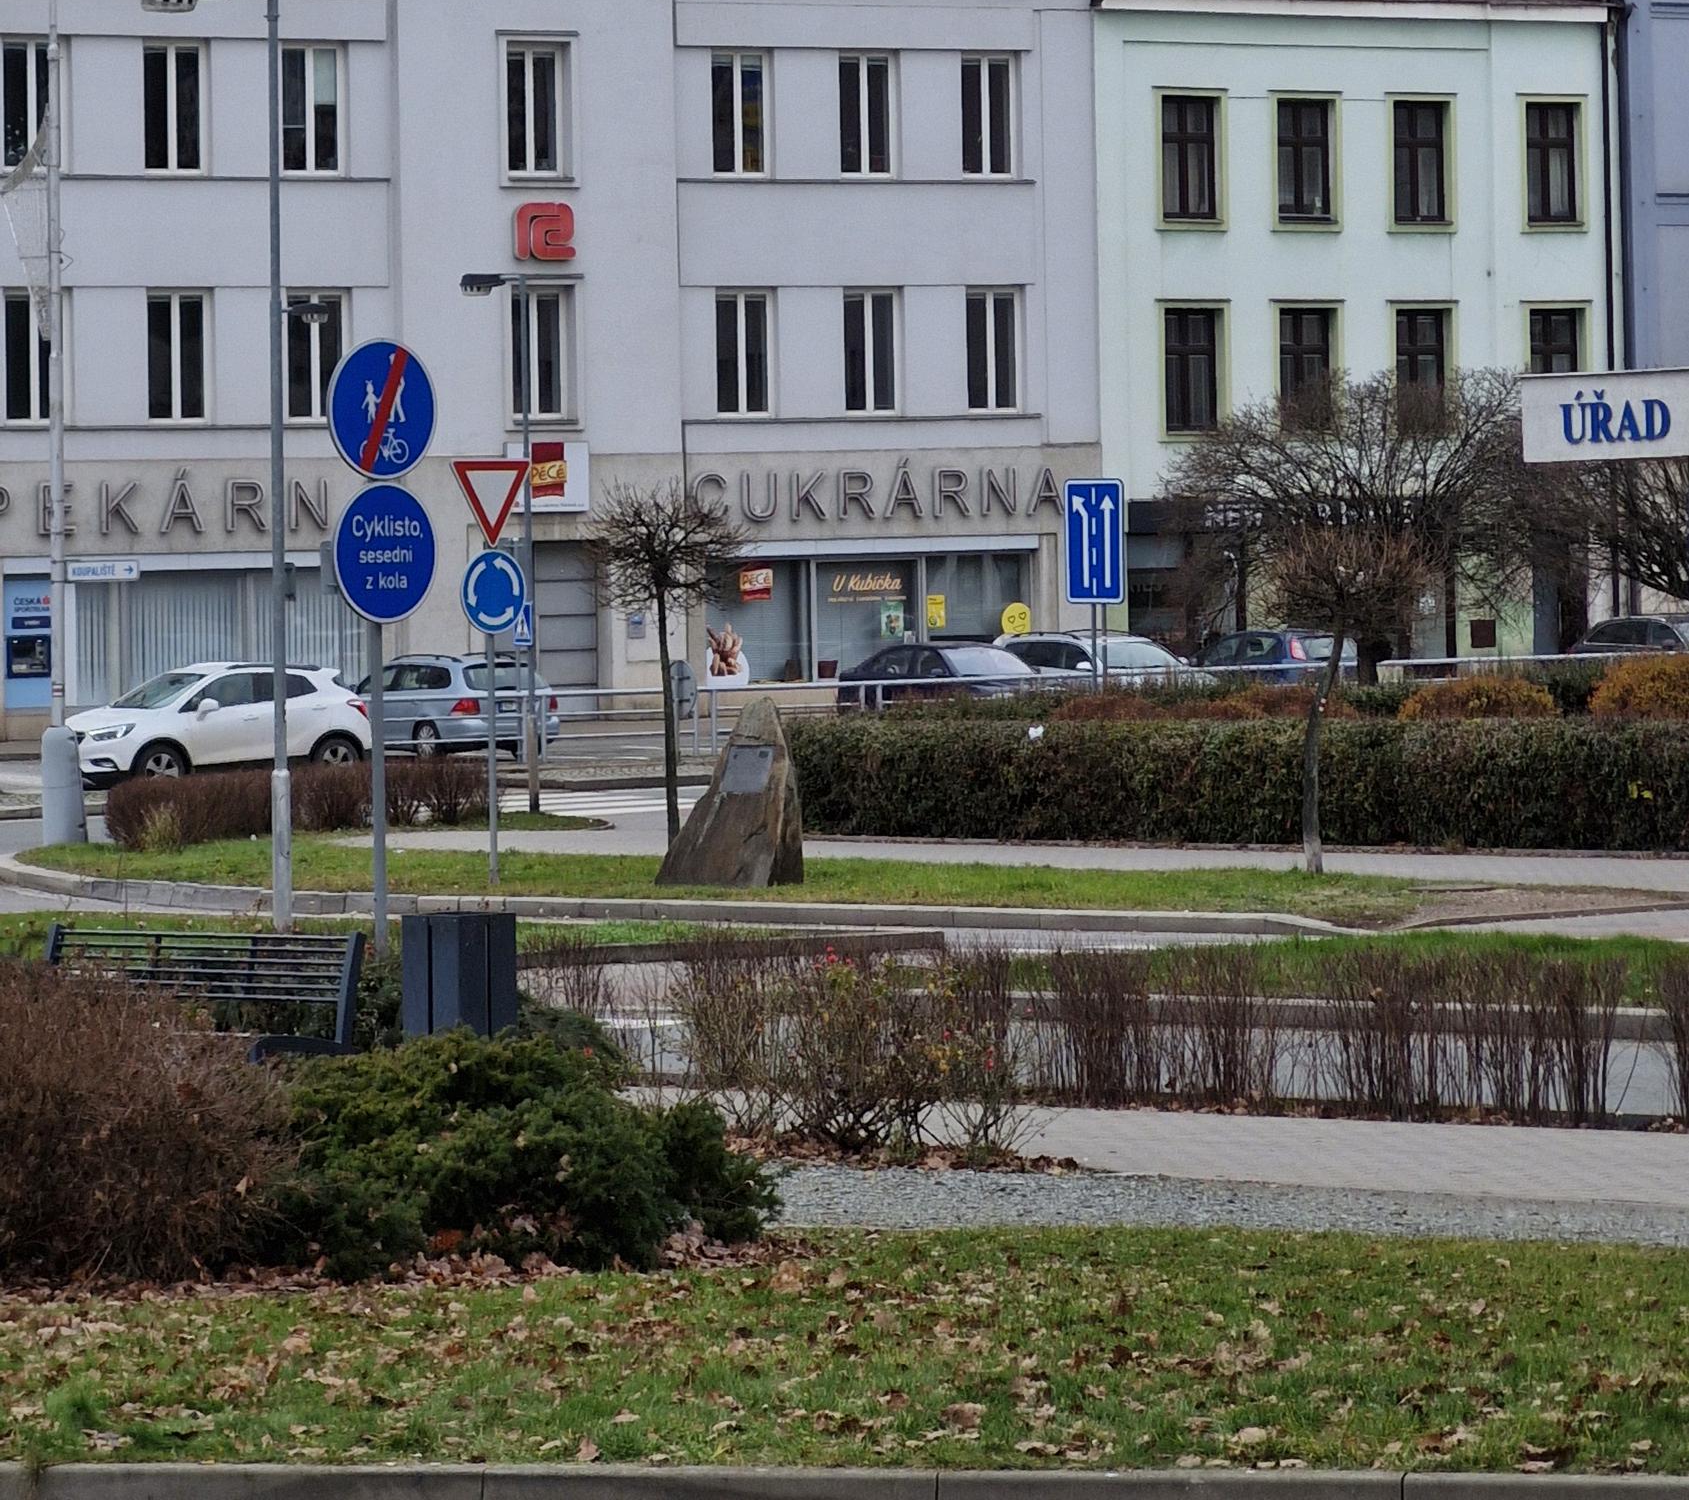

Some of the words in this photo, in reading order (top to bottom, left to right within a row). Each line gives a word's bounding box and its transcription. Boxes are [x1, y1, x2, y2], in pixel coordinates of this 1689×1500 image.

[1559, 389, 1671, 445] ÚŘAD
[692, 457, 1065, 523] CUKRÁRNA
[352, 514, 424, 543] Cyklisto,
[359, 545, 413, 564] sesedni
[365, 576, 374, 590] z
[378, 571, 408, 589] kola
[833, 574, 846, 592] U
